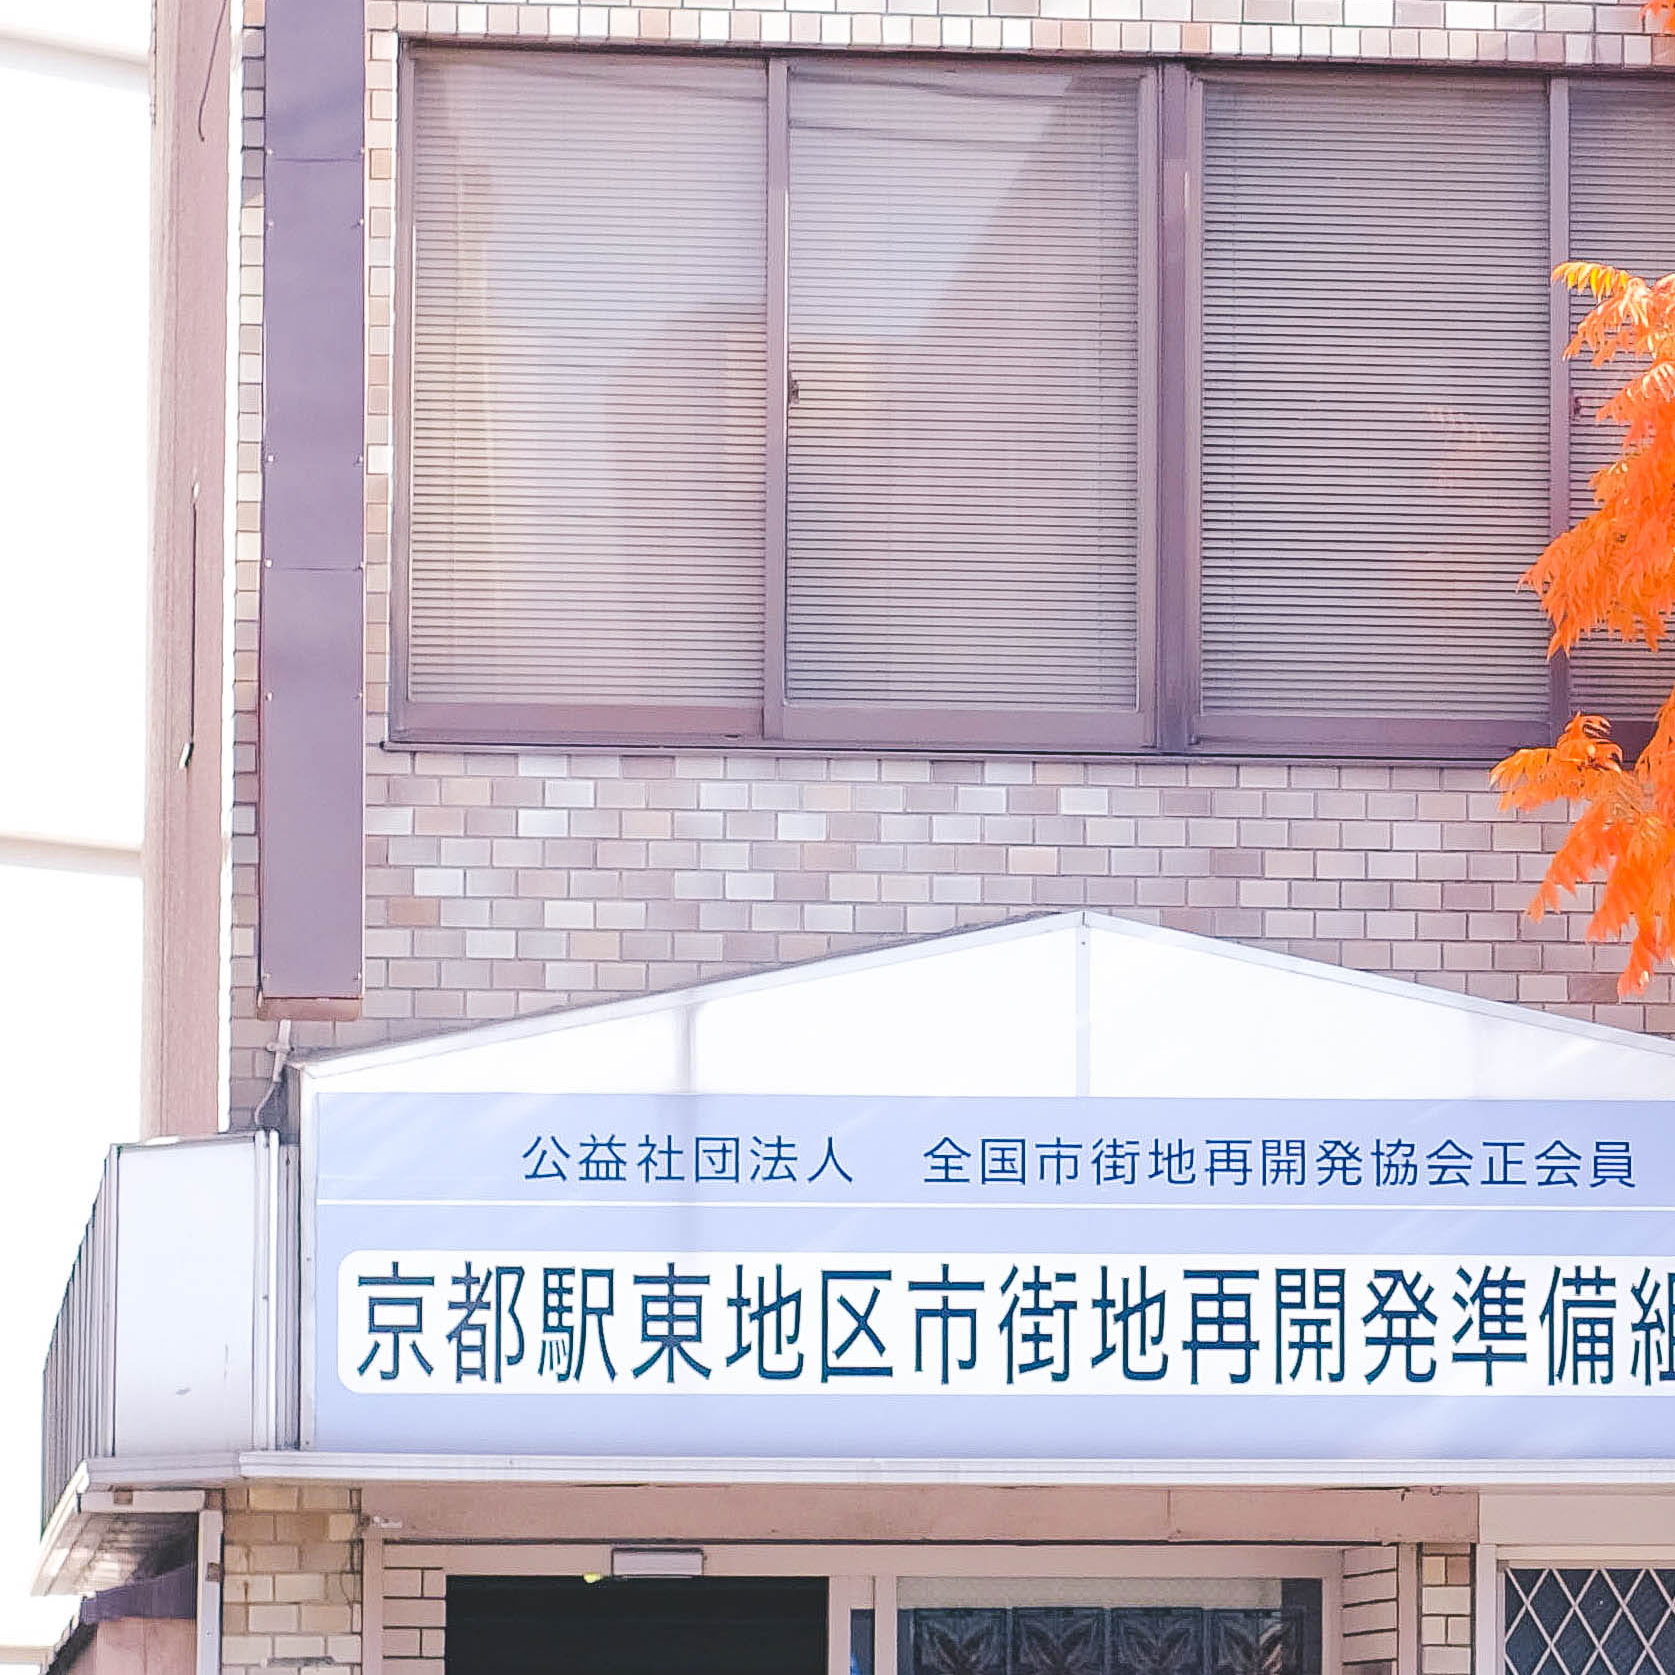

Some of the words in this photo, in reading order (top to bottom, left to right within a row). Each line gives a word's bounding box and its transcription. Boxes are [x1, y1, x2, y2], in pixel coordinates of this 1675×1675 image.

[521, 1133, 854, 1184] 公益社団法人
[922, 1135, 1638, 1189] 全国市街地再開発協会正会員
